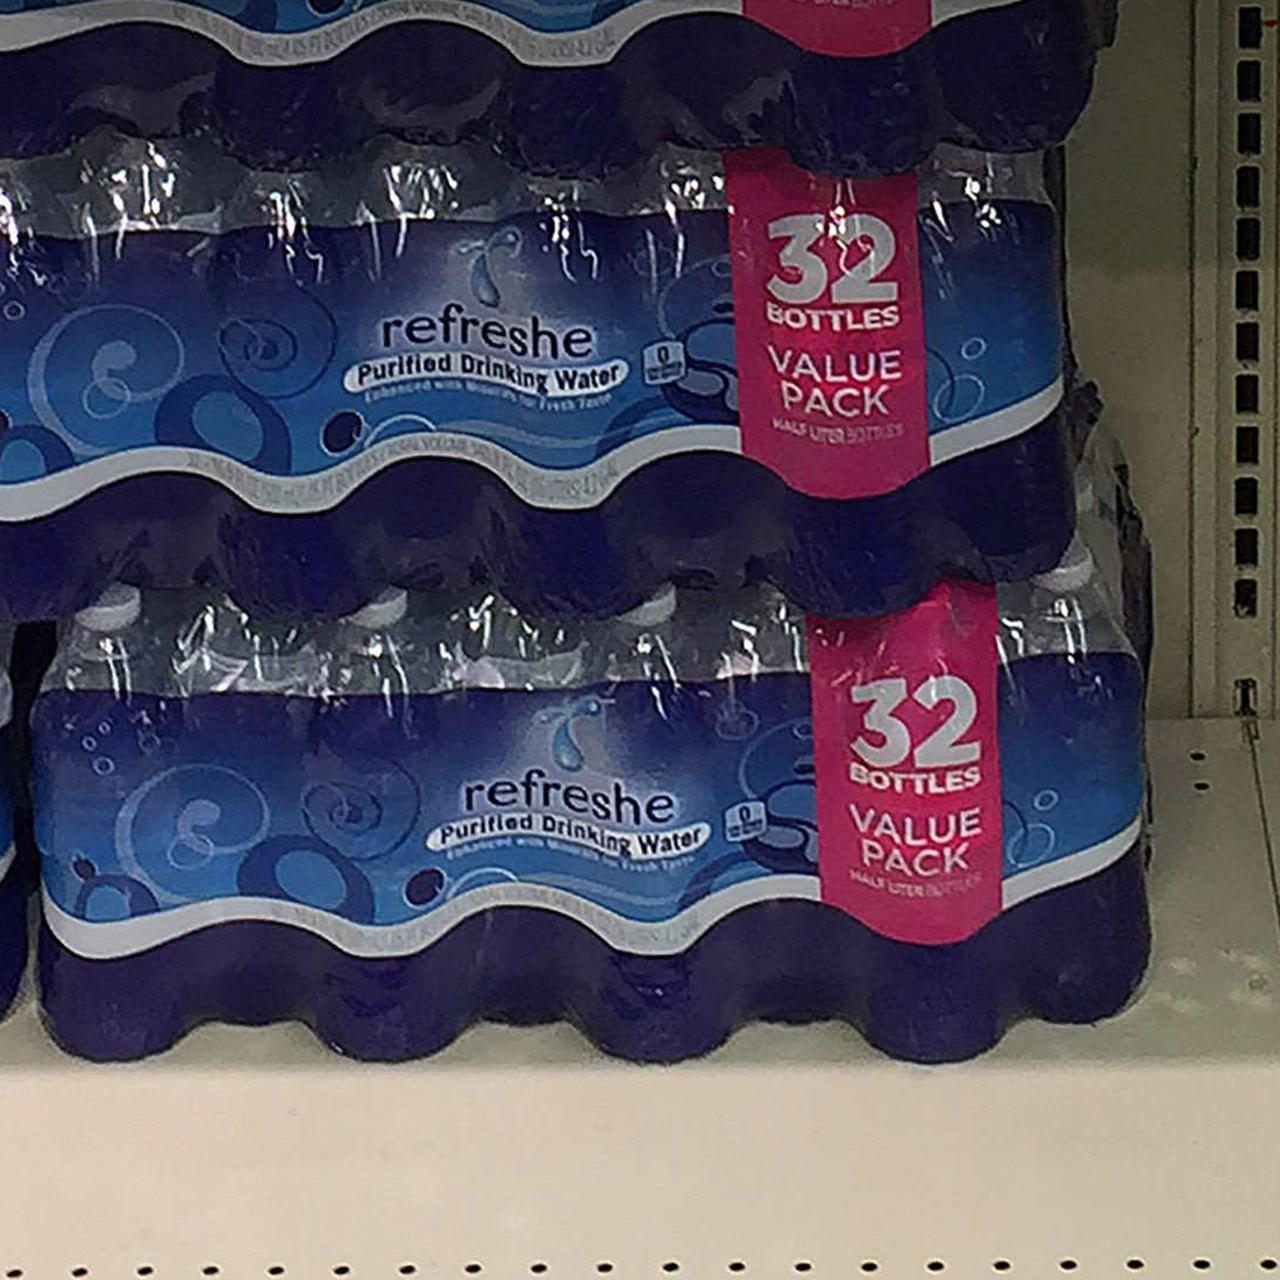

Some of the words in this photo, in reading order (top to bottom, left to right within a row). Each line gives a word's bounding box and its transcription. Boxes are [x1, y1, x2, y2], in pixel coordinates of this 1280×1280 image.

[766, 213, 898, 304] 32
[382, 303, 593, 359] refreshe
[766, 301, 900, 332] BOTTLES
[357, 354, 452, 386] Purified
[461, 354, 548, 394] Drinking
[555, 365, 621, 391] Water
[767, 344, 902, 383] VALUE
[780, 379, 890, 418] PACK
[850, 675, 981, 768] 32
[464, 769, 674, 825] refreshe
[849, 762, 981, 795] BOTTLES
[440, 815, 533, 845] Purified
[542, 815, 632, 858] Drinking
[637, 828, 702, 856] Water
[849, 803, 982, 847] VALUE
[861, 837, 970, 877] PACK
